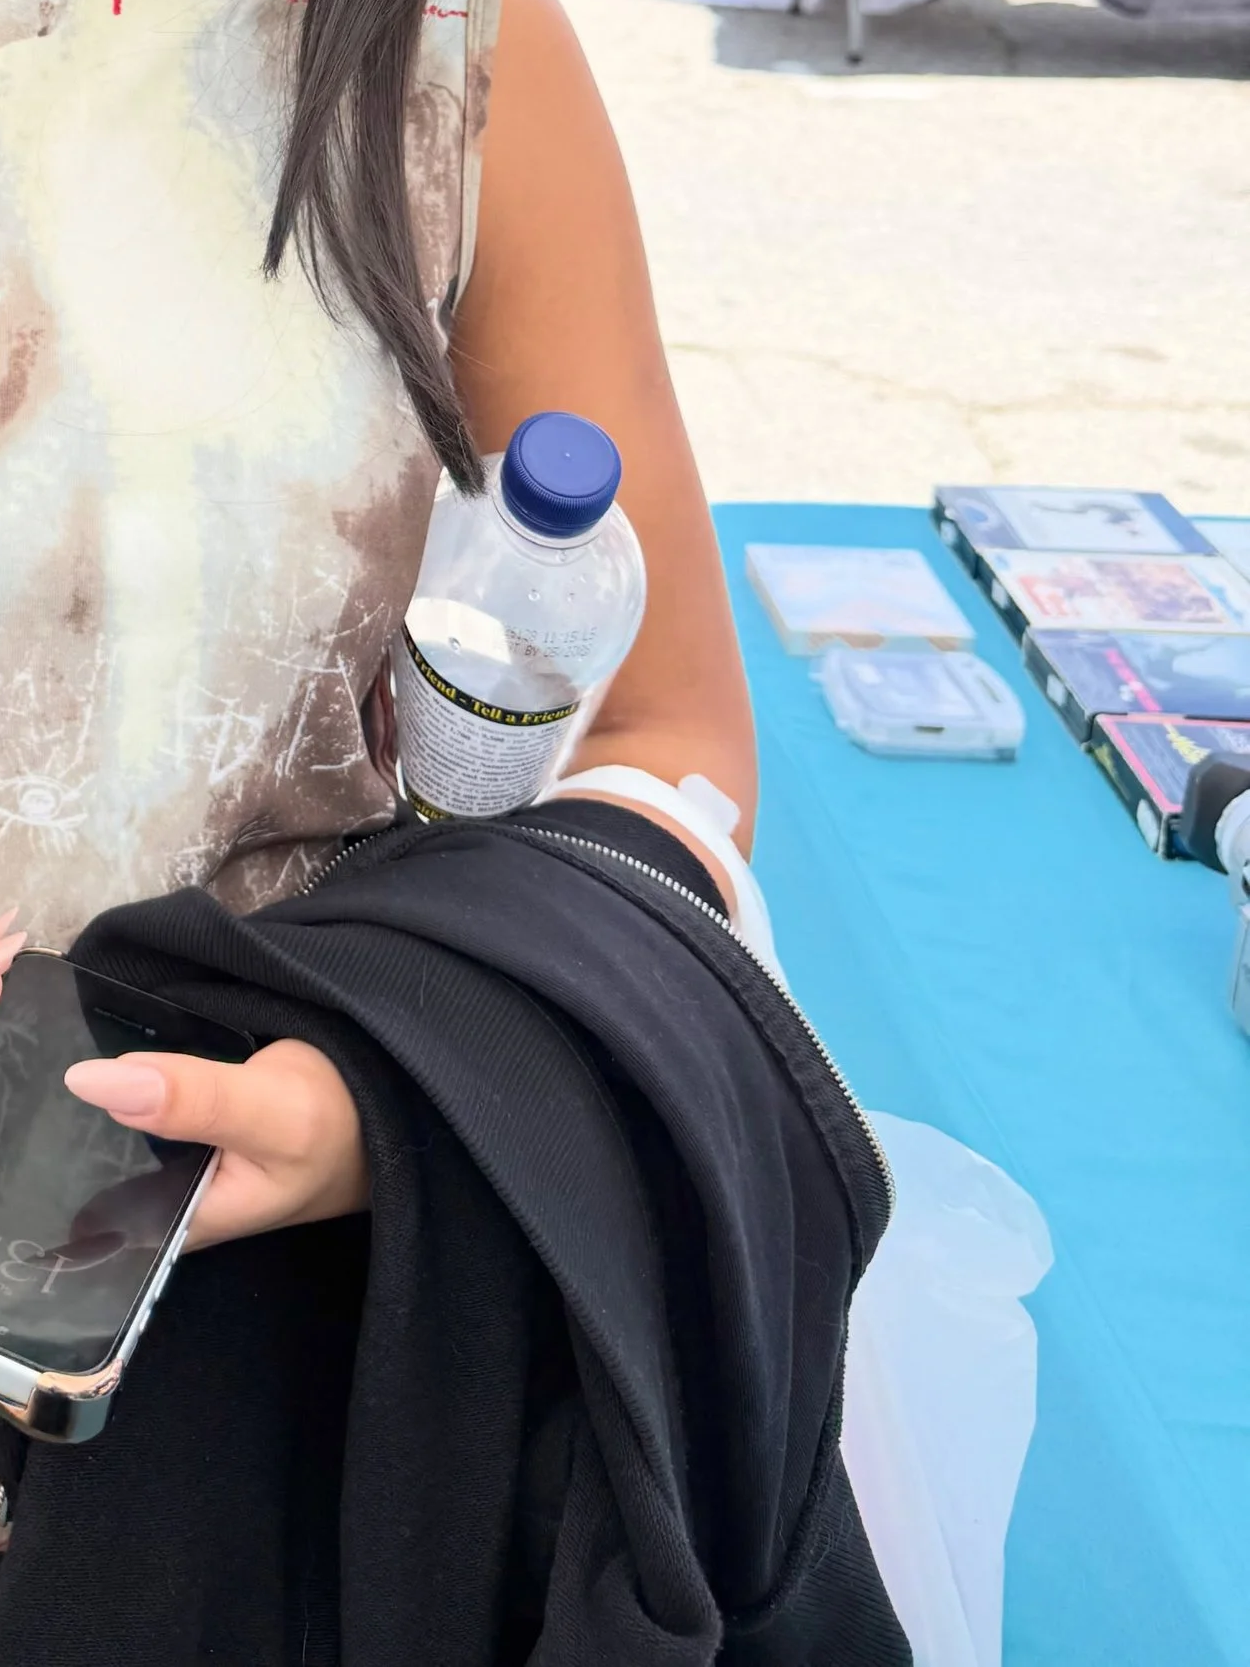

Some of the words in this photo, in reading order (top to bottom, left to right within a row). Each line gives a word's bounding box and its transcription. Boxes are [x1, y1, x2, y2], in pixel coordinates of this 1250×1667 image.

[413, 651, 457, 700] Friend
[470, 700, 502, 722] Tell
[505, 713, 517, 724] a
[521, 702, 577, 724] Friend
